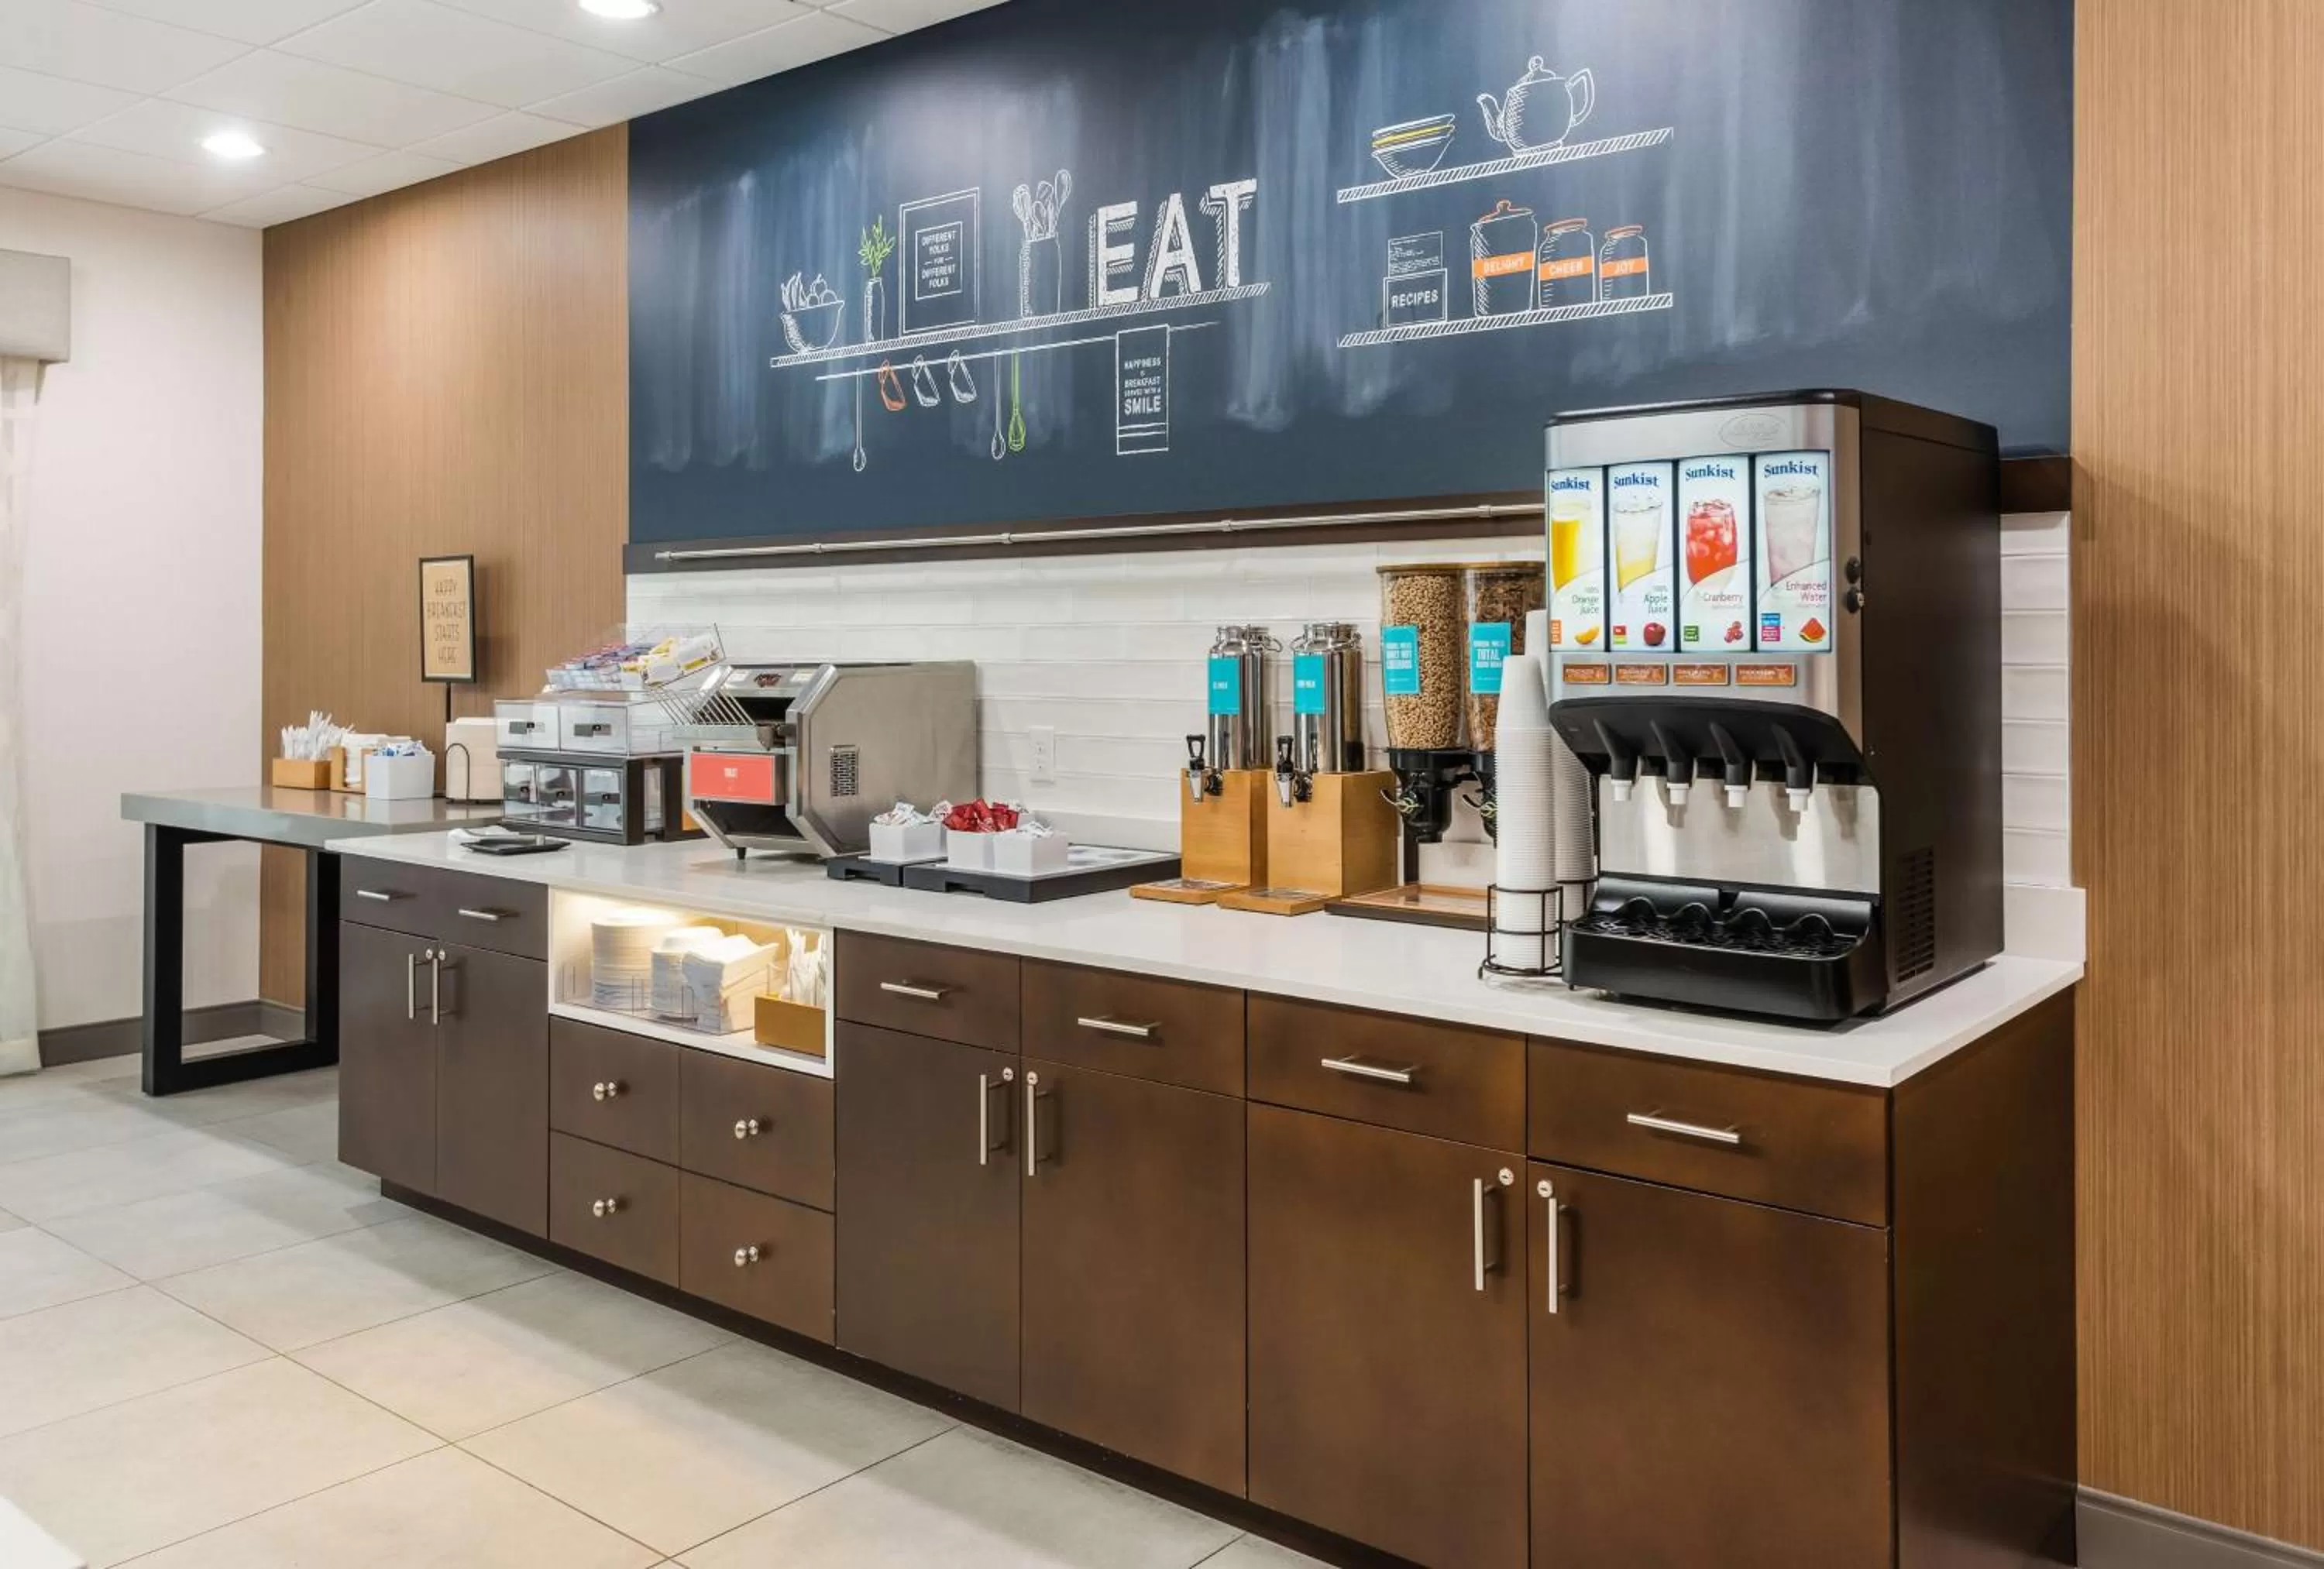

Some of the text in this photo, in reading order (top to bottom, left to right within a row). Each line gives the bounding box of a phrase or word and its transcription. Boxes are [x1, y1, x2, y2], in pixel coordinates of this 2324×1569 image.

[1088, 177, 1258, 308] EAT
[1483, 256, 1525, 274] DELIGHT
[1549, 260, 1583, 275] CHEER
[1615, 261, 1635, 274] JOY
[1391, 289, 1439, 308] RECIPES
[1124, 395, 1161, 415] SMILE
[1685, 465, 1736, 481] Sunkist
[1765, 461, 1820, 478] Sunkist
[1550, 477, 1591, 493] Sunkist
[1614, 472, 1659, 489] Sunkist
[1786, 581, 1827, 592] Enhanced
[1571, 594, 1600, 606] Orange
[1643, 594, 1668, 606] Apple
[1703, 592, 1744, 603] Cranberry
[1800, 592, 1827, 603] Water
[1477, 648, 1501, 661] TOTAL
